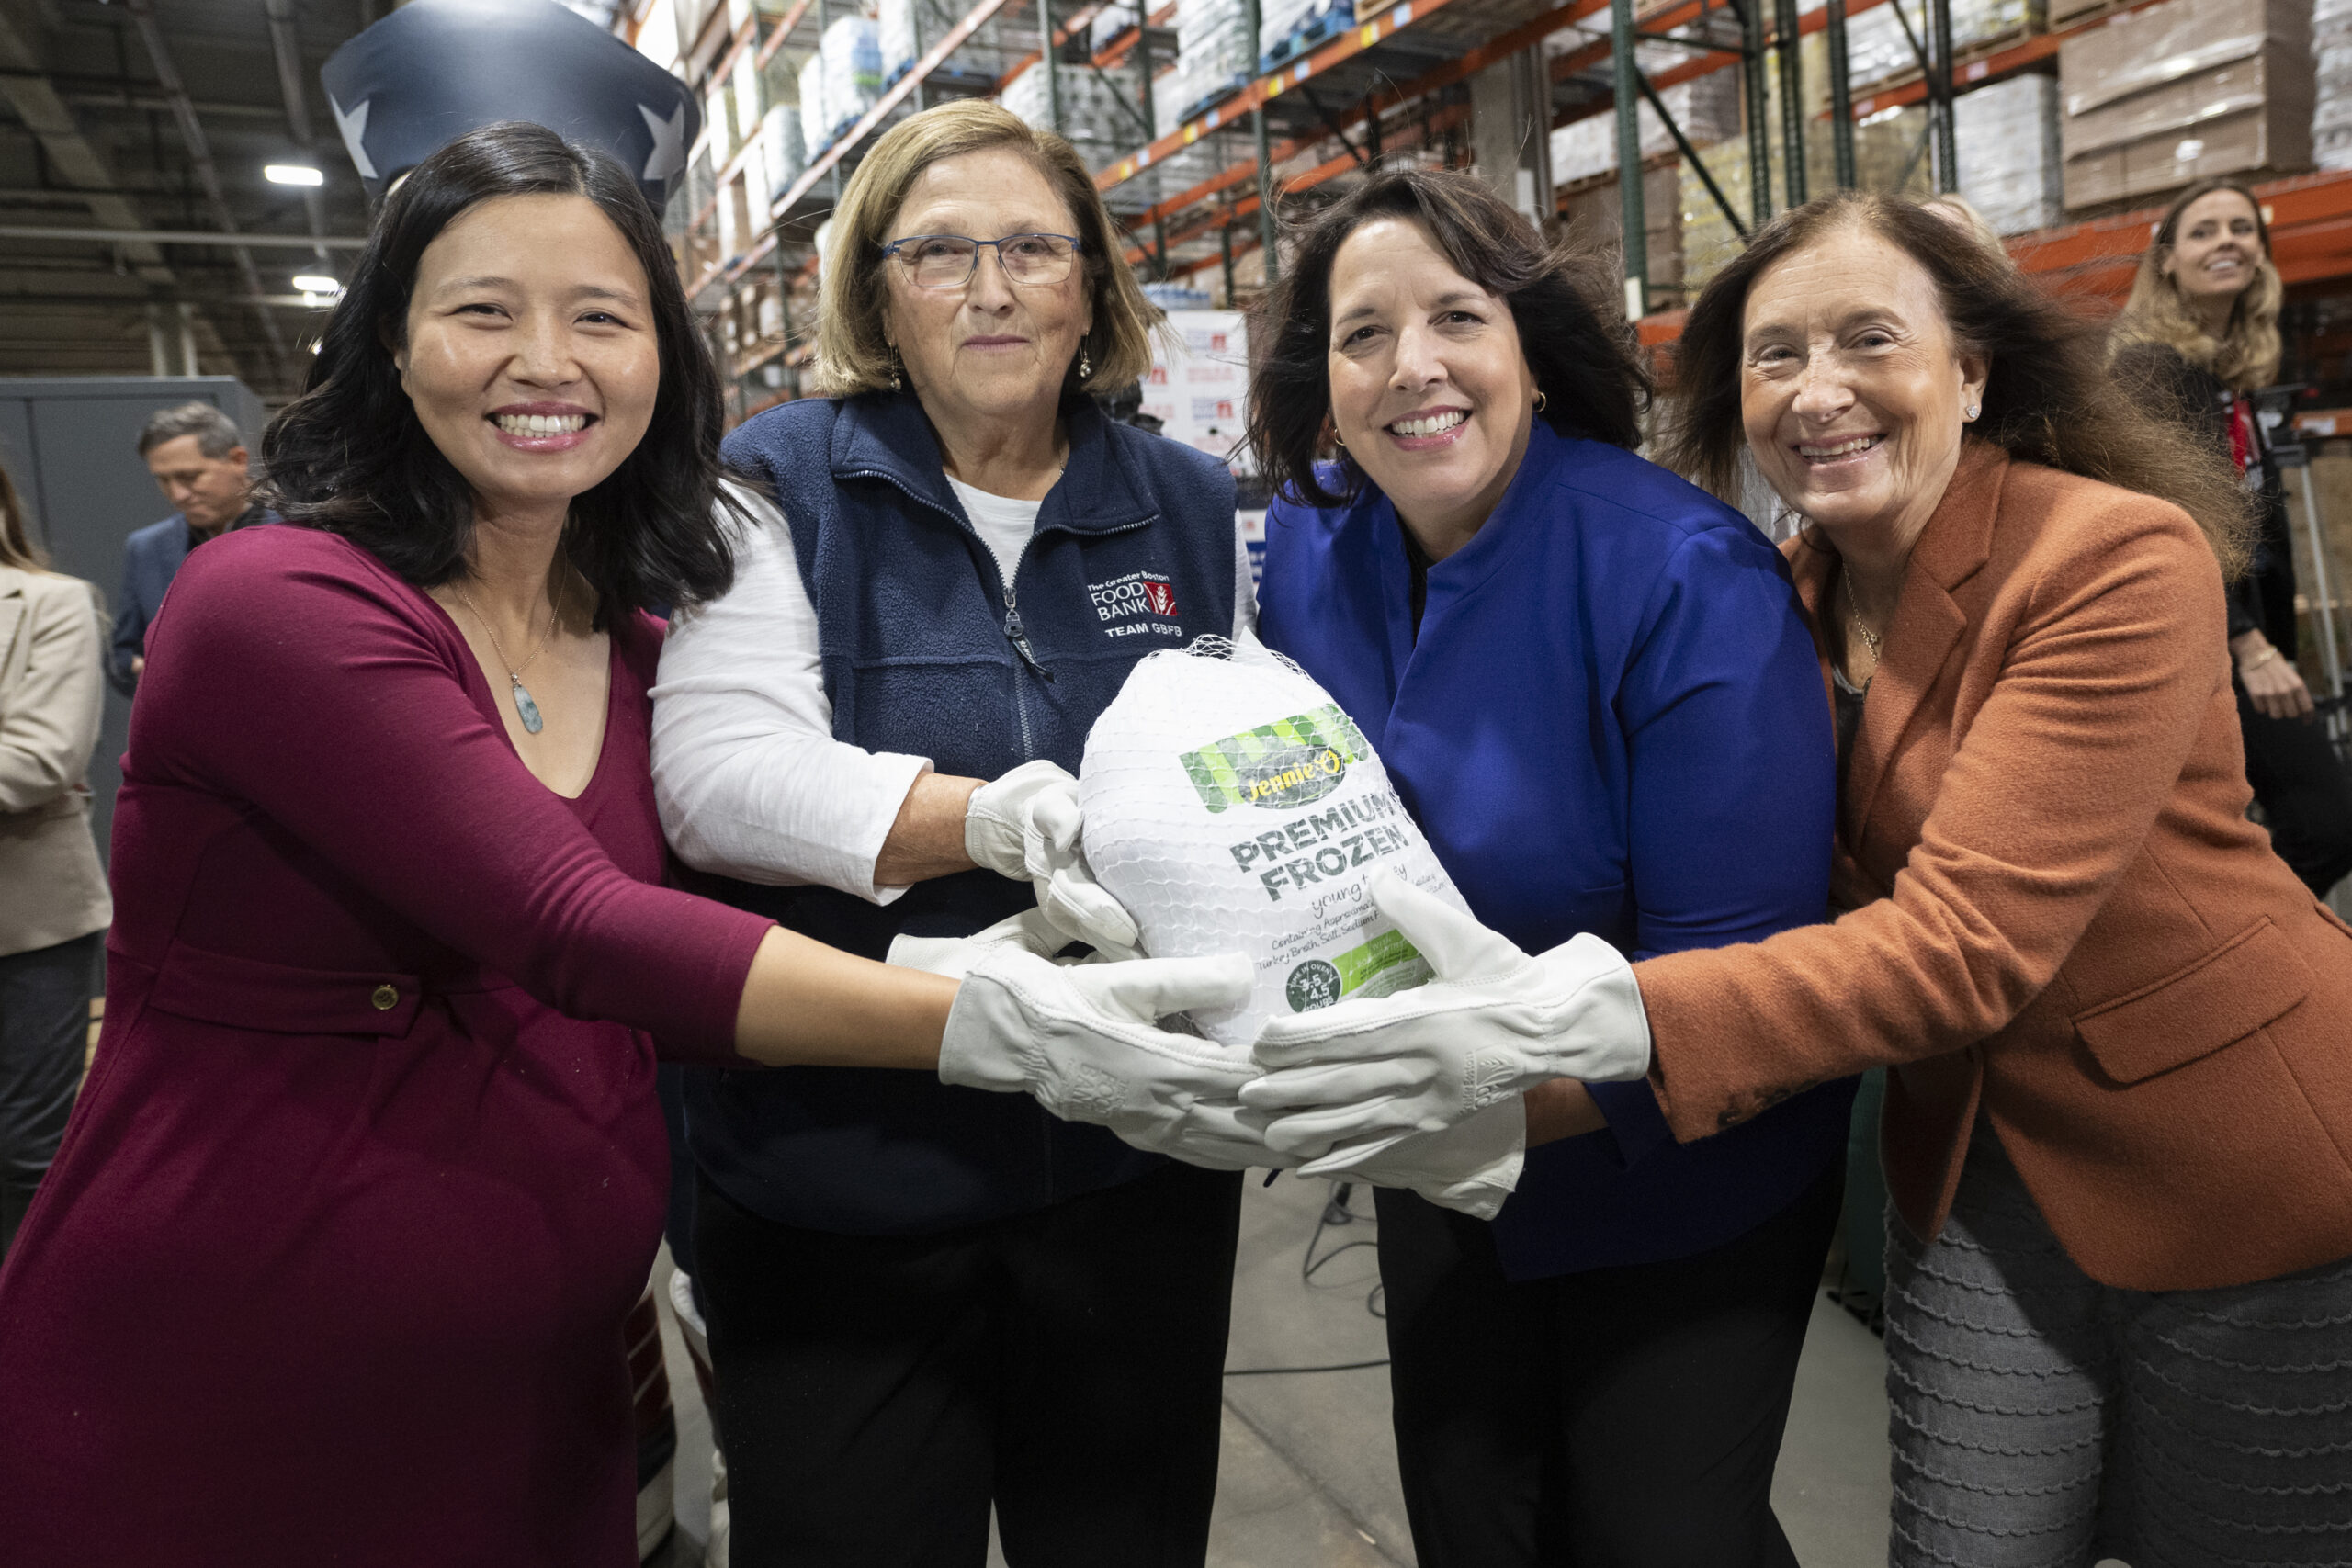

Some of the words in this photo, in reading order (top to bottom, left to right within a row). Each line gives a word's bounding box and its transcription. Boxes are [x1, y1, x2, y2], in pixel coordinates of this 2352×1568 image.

[1087, 583, 1104, 592] The
[1105, 572, 1141, 587] Greater
[1141, 570, 1170, 581] Boston
[1091, 581, 1145, 606] FOOD
[1097, 597, 1150, 621] BANK
[1104, 623, 1149, 637] TEAM
[1151, 622, 1182, 637] GBFB
[1229, 792, 1395, 874] PREMIUM
[1260, 822, 1409, 902] FROZEN
[1311, 883, 1363, 919] young
[1310, 963, 1332, 976] OVEN
[1299, 974, 1322, 992] 3.5
[1310, 986, 1330, 1000] 4.5
